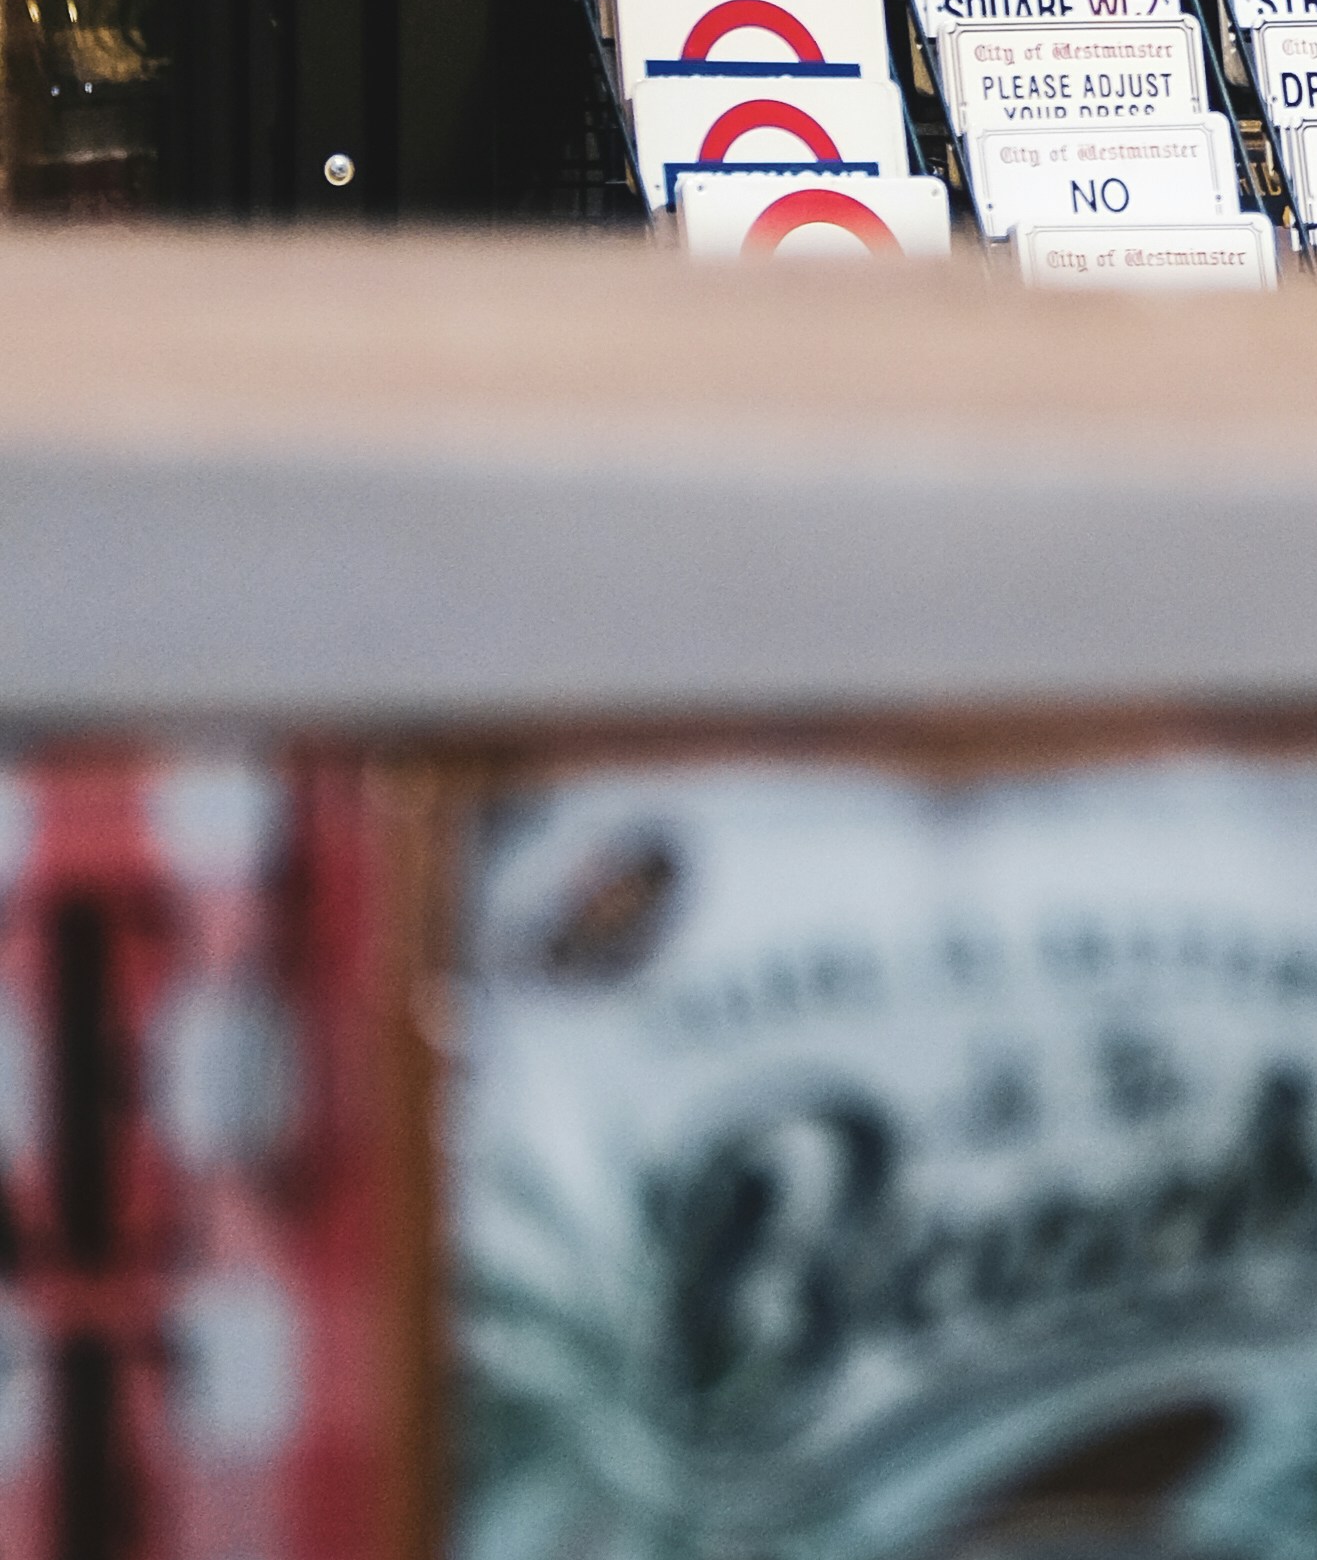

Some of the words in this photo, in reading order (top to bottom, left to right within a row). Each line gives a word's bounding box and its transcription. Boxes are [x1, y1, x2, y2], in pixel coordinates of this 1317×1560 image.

[983, 74, 1071, 100] PLEASE
[1083, 73, 1172, 98] ADJUST
[1070, 178, 1129, 214] NO
